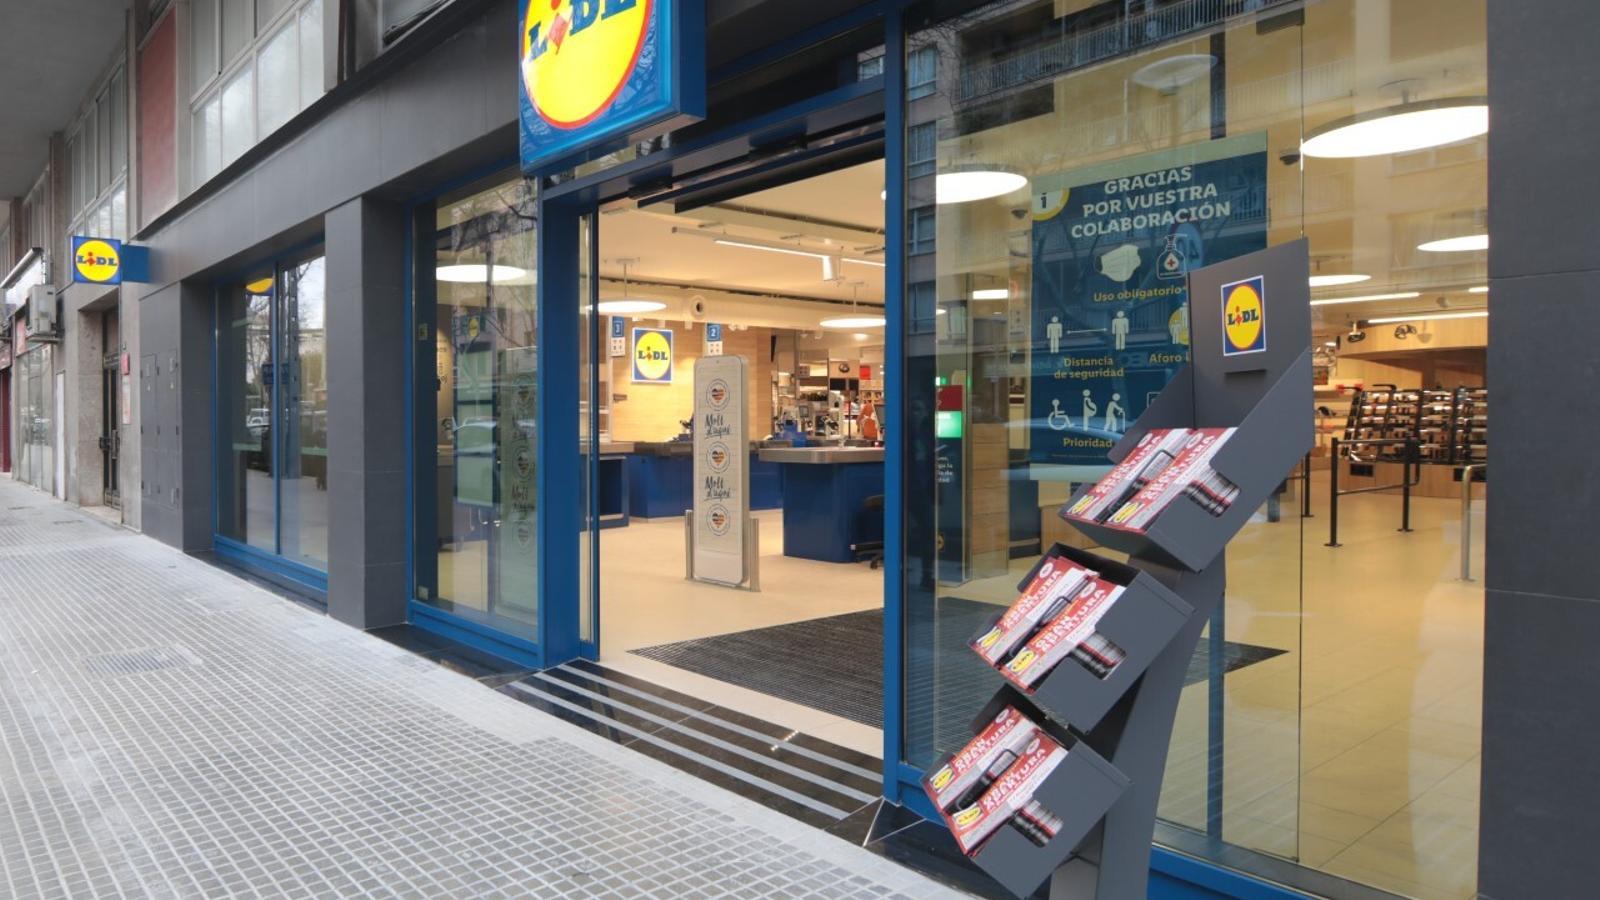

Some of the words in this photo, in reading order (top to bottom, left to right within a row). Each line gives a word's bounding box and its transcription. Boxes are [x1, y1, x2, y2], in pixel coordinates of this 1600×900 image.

[1104, 166, 1192, 195] GRACIAS
[1082, 198, 1122, 218] POR
[1126, 183, 1218, 209] VUESTRA
[1071, 201, 1231, 238] COLABORACIÓN
[1093, 292, 1115, 302] Uso
[1063, 356, 1114, 367] Distancia
[1149, 353, 1182, 363] Aforo
[1054, 369, 1067, 379] de
[1069, 368, 1125, 380] seguridad
[1062, 437, 1113, 448] Prioridad
